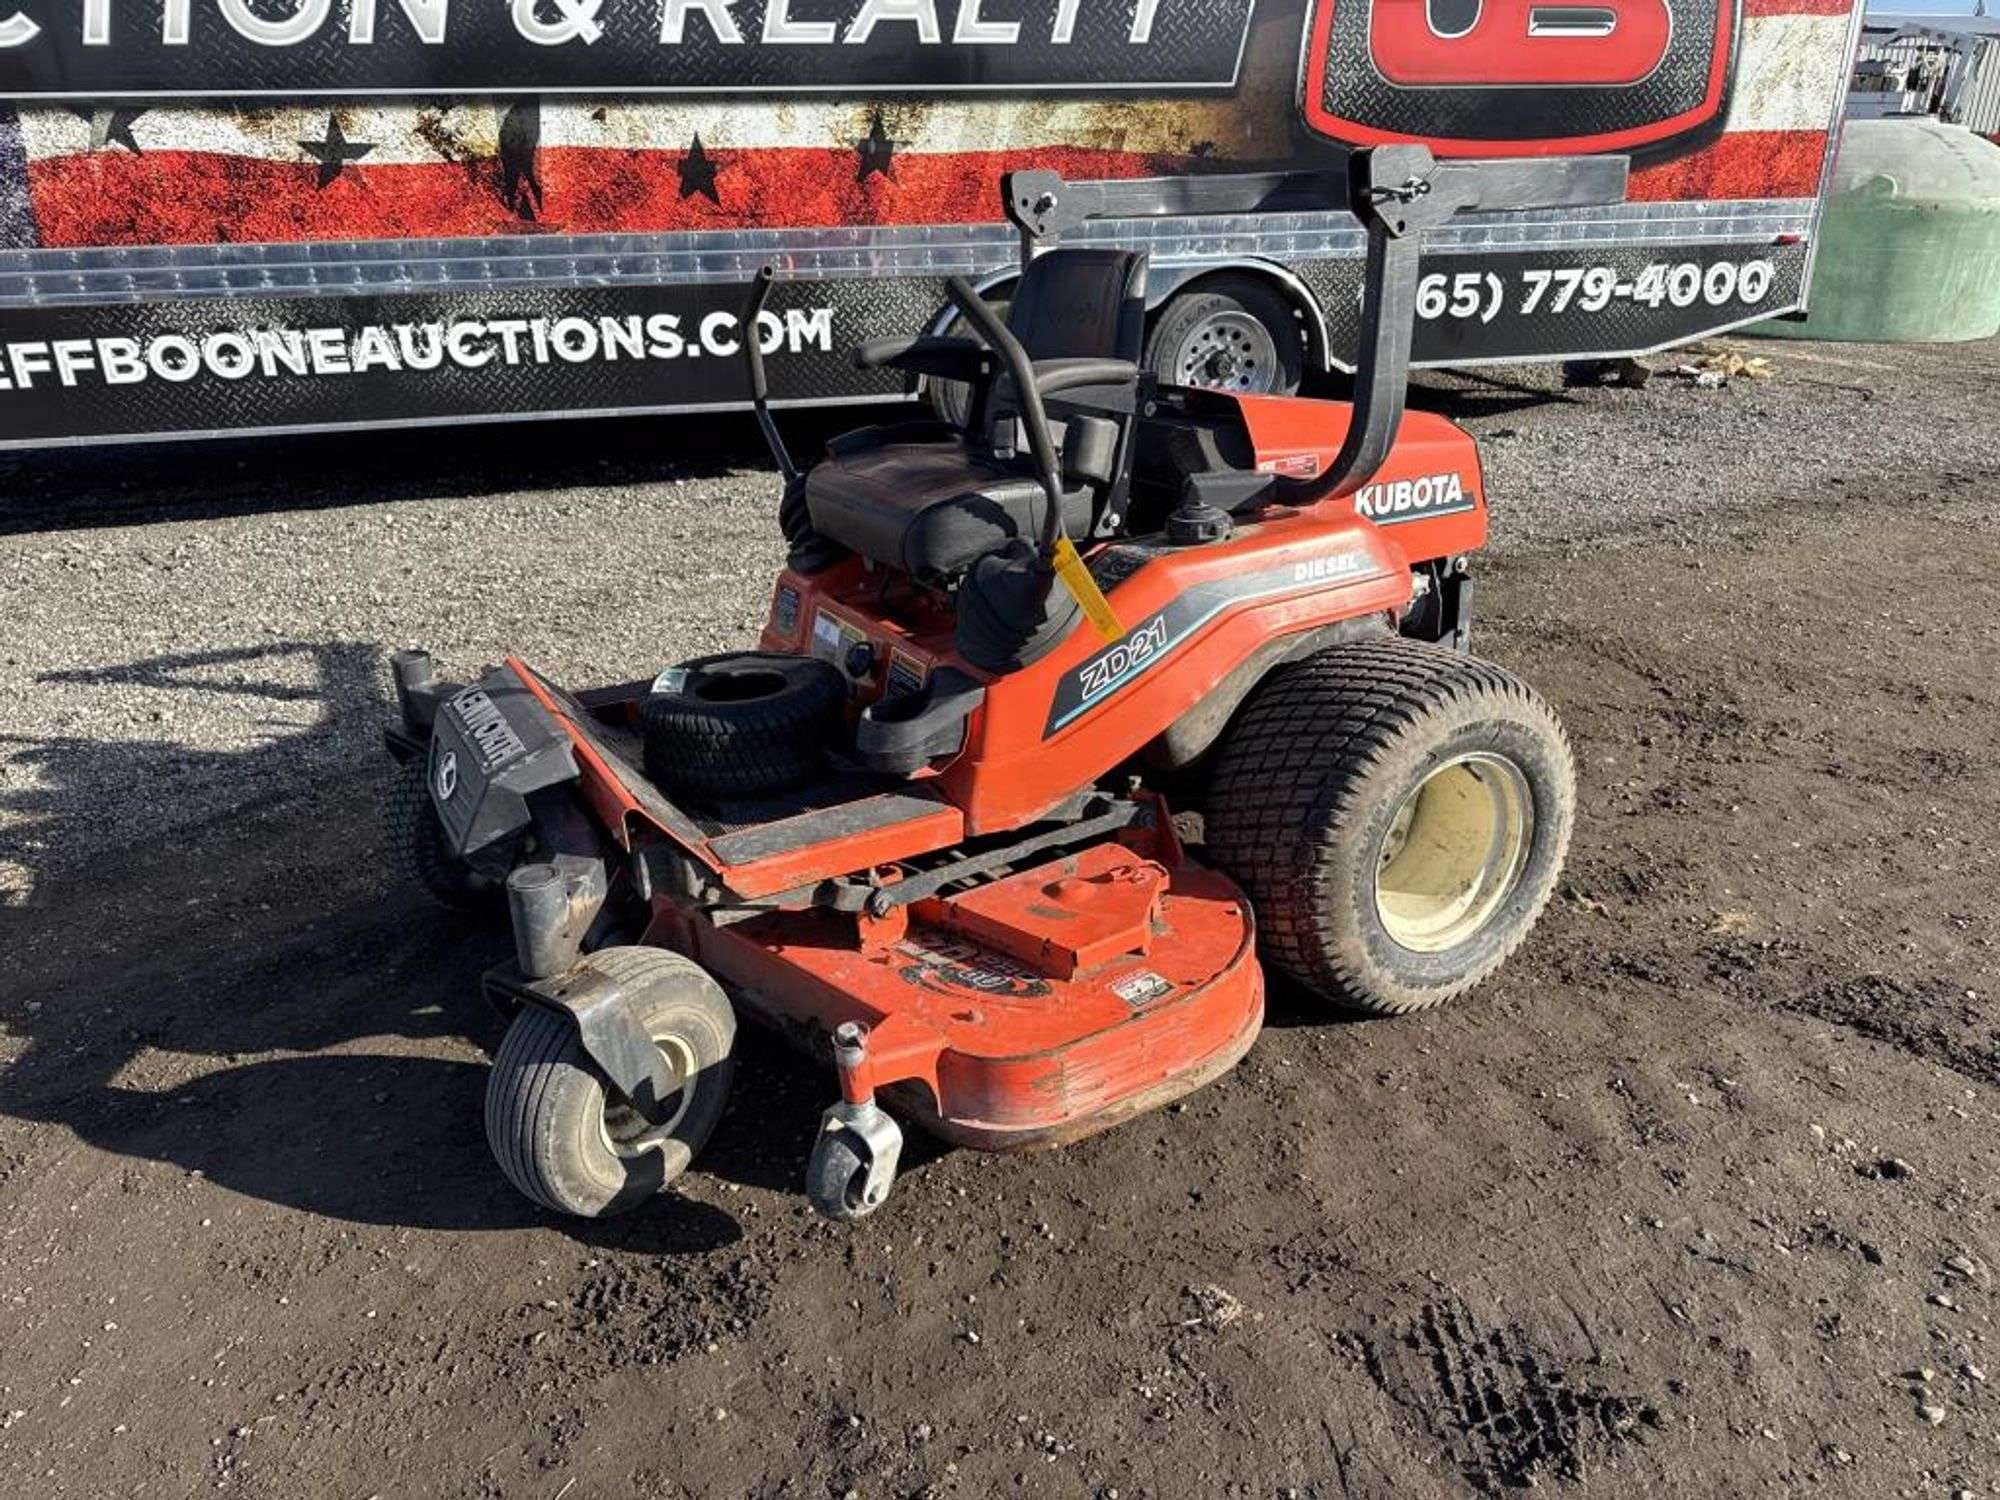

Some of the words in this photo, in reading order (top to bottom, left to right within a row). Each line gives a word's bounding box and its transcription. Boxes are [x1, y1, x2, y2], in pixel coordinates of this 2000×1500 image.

[1520, 260, 1771, 315] 779-4000
[0, 308, 833, 390] FFBOONEAUCTIONS.COM
[1355, 473, 1463, 516] KUBOTA
[1294, 554, 1360, 581] DIESEL
[1080, 615, 1167, 700] ZD21
